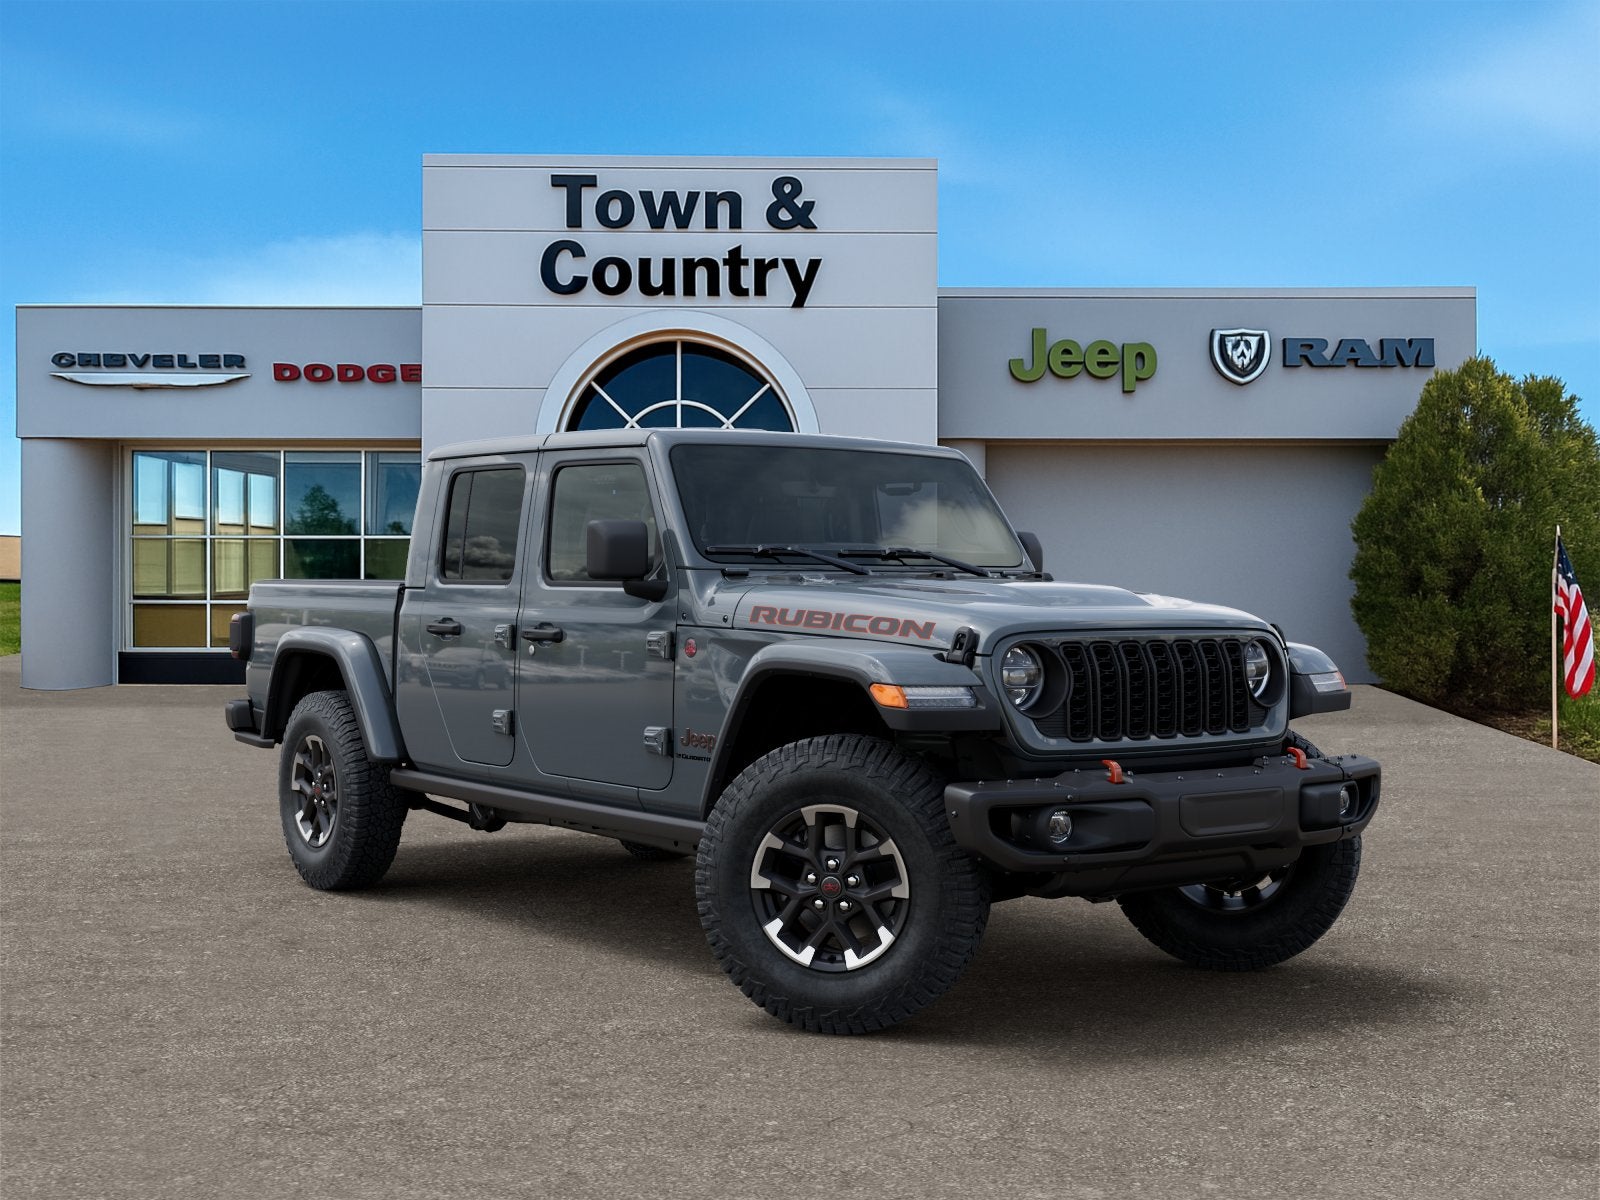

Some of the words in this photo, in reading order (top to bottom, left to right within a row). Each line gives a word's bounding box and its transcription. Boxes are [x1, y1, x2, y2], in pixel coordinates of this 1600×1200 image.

[550, 174, 742, 229] Town
[765, 176, 818, 230] &
[540, 239, 822, 308] Country
[1008, 327, 1158, 393] Jeep
[1282, 337, 1435, 368] RAM
[273, 363, 422, 383] DODGE
[750, 605, 936, 640] RUBICON
[680, 727, 717, 754] Jeep
